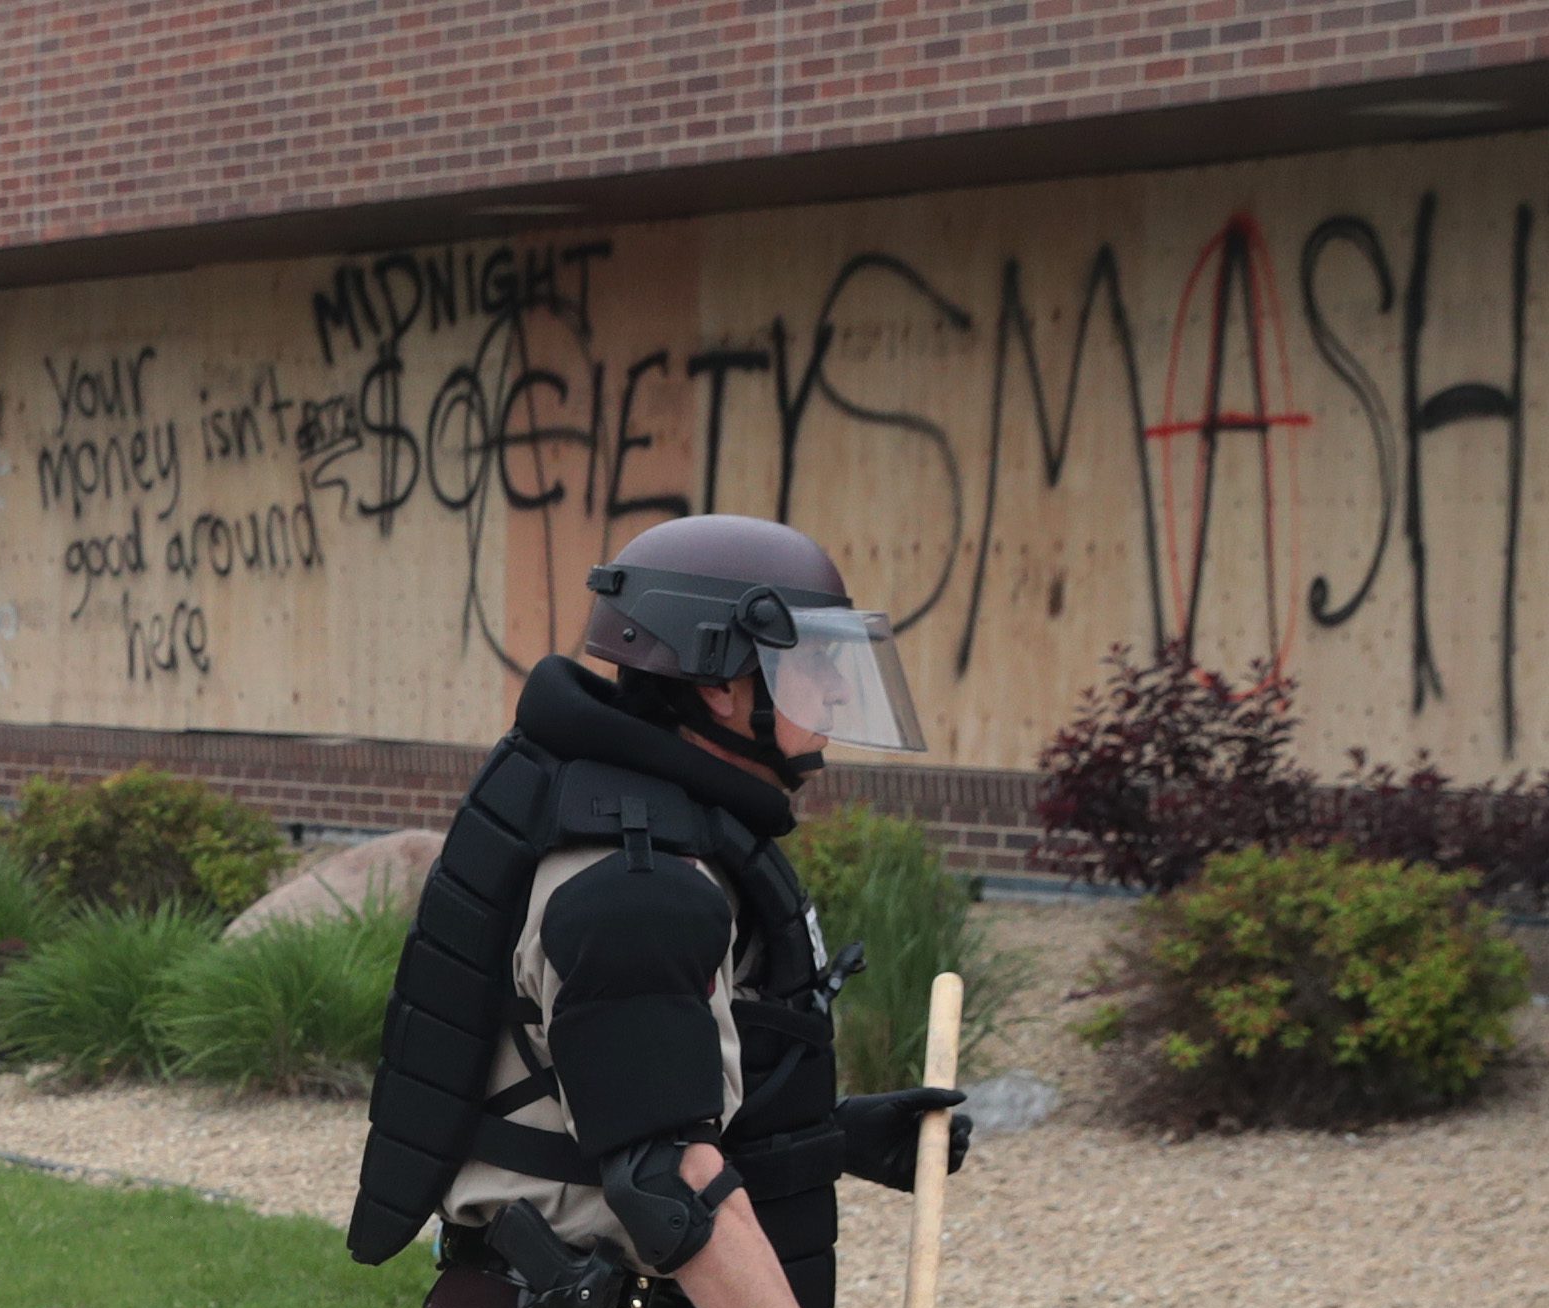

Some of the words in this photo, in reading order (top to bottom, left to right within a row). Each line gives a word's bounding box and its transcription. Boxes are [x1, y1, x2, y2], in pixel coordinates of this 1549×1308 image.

[313, 240, 613, 366] MIDNIGHT
[37, 420, 182, 521] money
[812, 190, 1535, 760] SMASH
[64, 506, 147, 621] good
[165, 470, 325, 582] around
[122, 590, 211, 682] here
